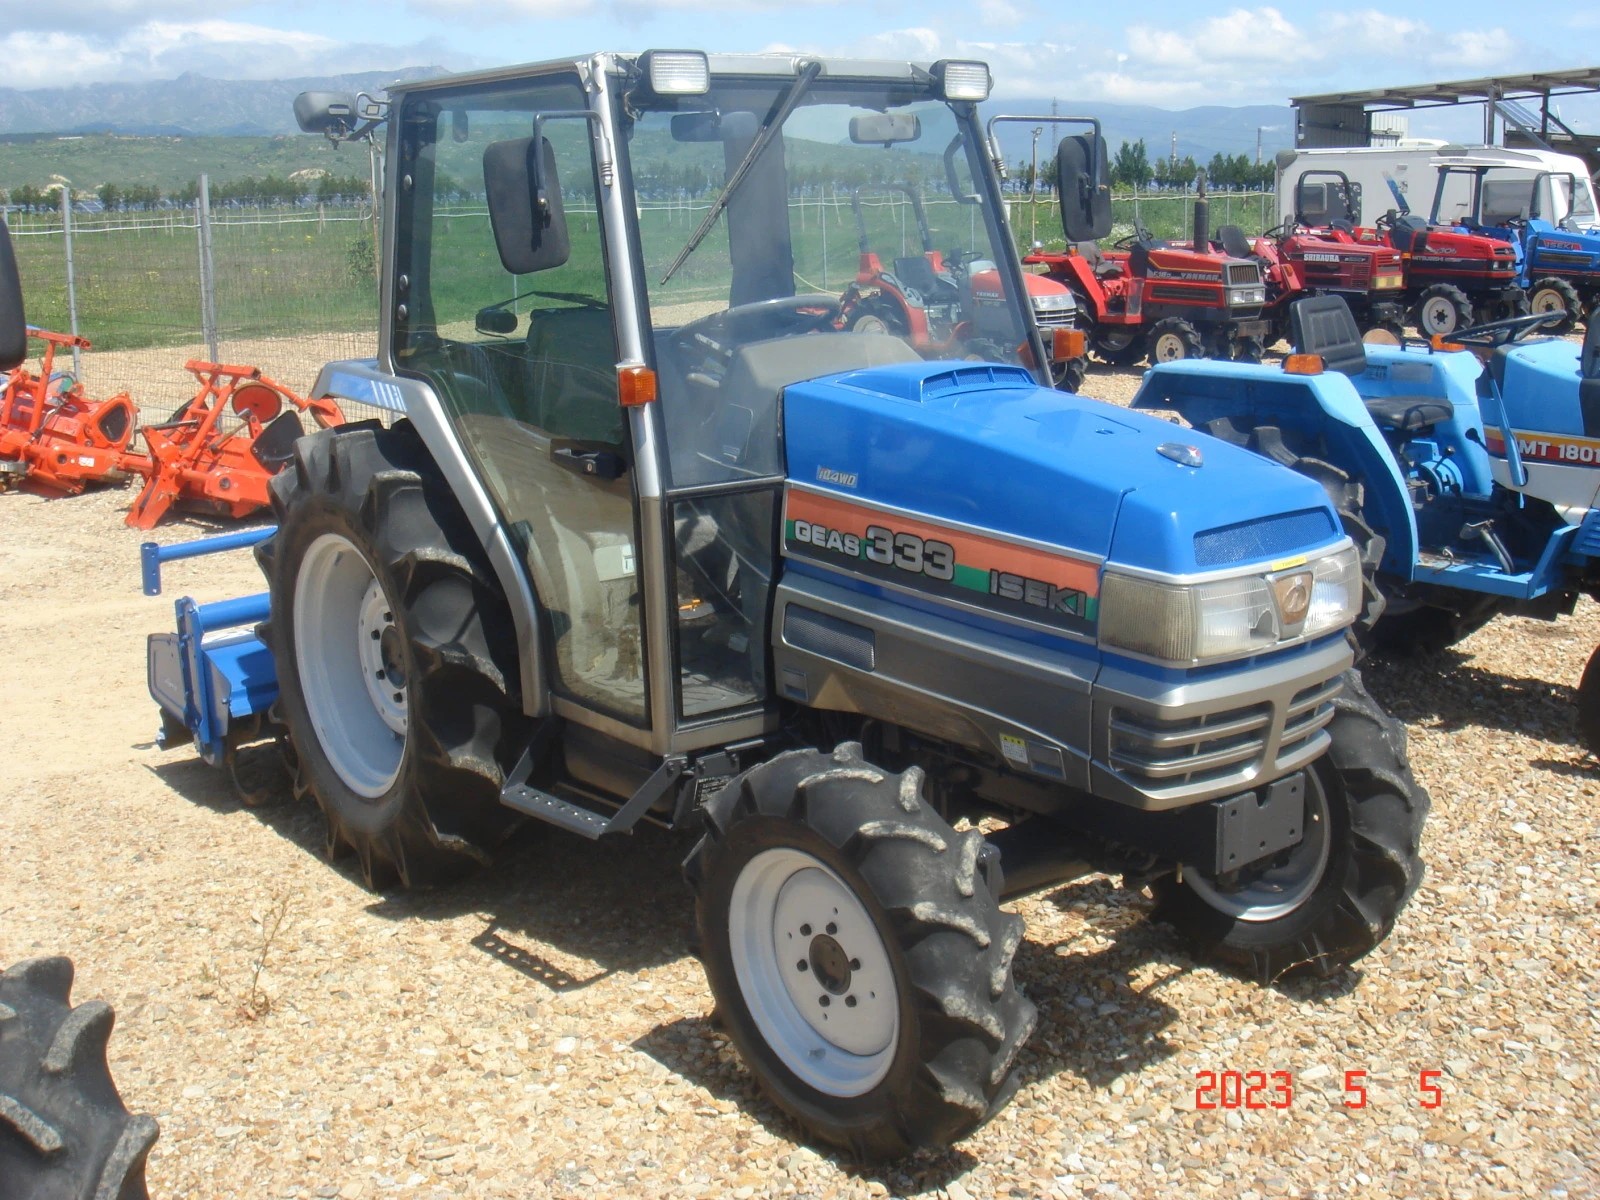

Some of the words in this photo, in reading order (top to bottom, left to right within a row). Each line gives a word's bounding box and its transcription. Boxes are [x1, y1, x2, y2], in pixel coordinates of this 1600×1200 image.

[1303, 253, 1340, 262] SHIBAURA
[1180, 272, 1221, 281] YANMAR
[1519, 439, 1551, 457] MT
[794, 519, 860, 557] GEAS
[866, 525, 955, 581] 333
[988, 568, 1088, 618] ISEKI
